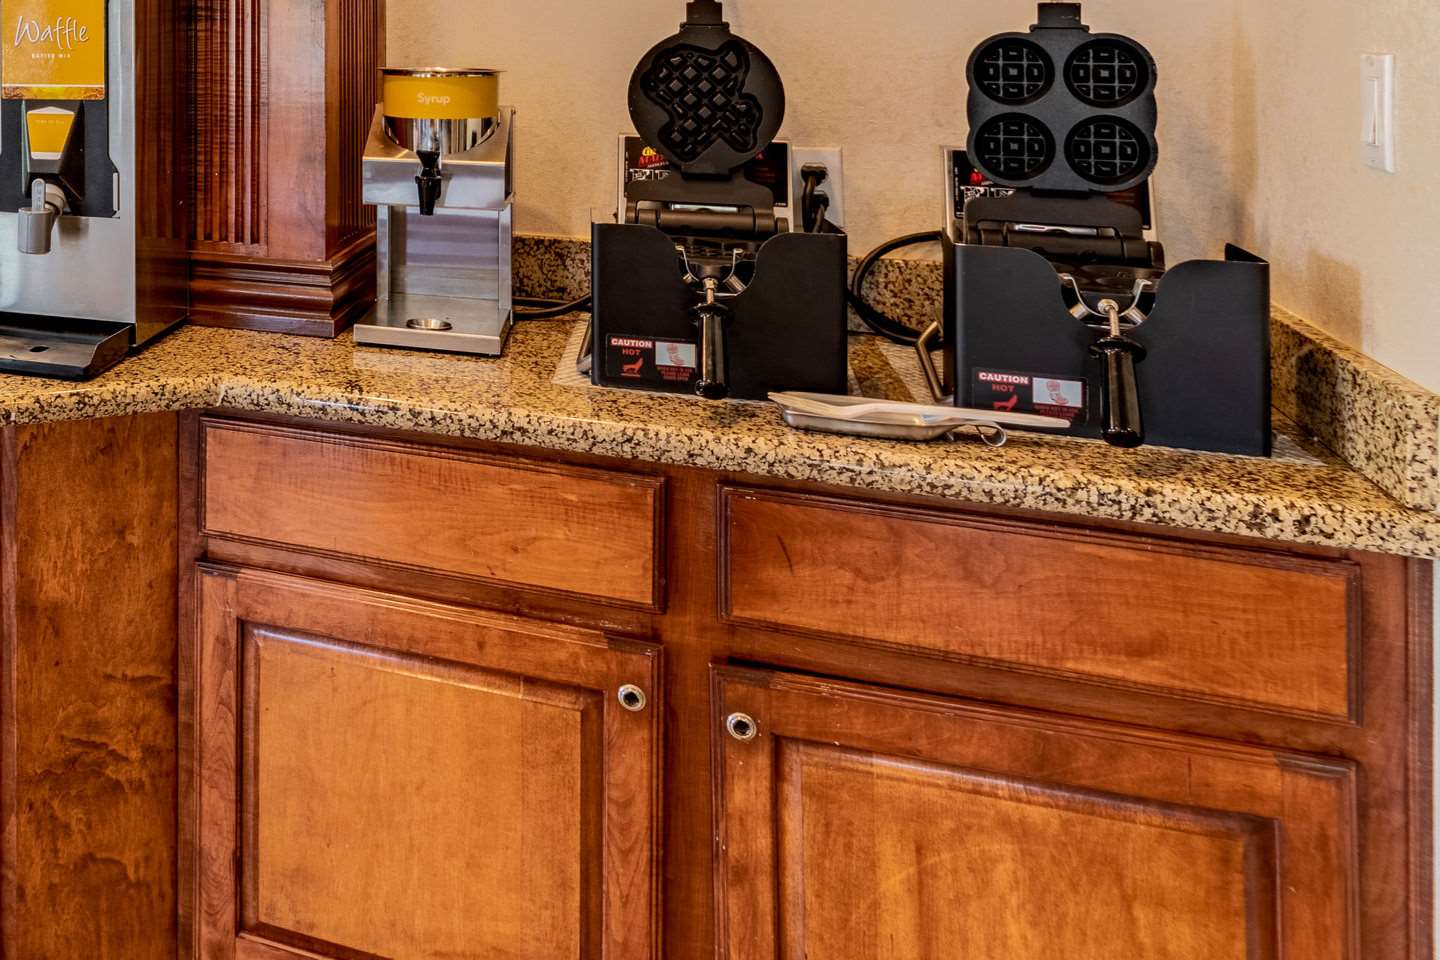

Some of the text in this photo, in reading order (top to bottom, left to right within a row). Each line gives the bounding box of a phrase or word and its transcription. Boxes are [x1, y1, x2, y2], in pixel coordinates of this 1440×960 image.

[14, 15, 89, 50] Waffle
[417, 92, 451, 106] Syrup
[610, 338, 653, 349] CAUTION
[978, 372, 1029, 385] CAUTION
[991, 384, 1015, 392] HOT
